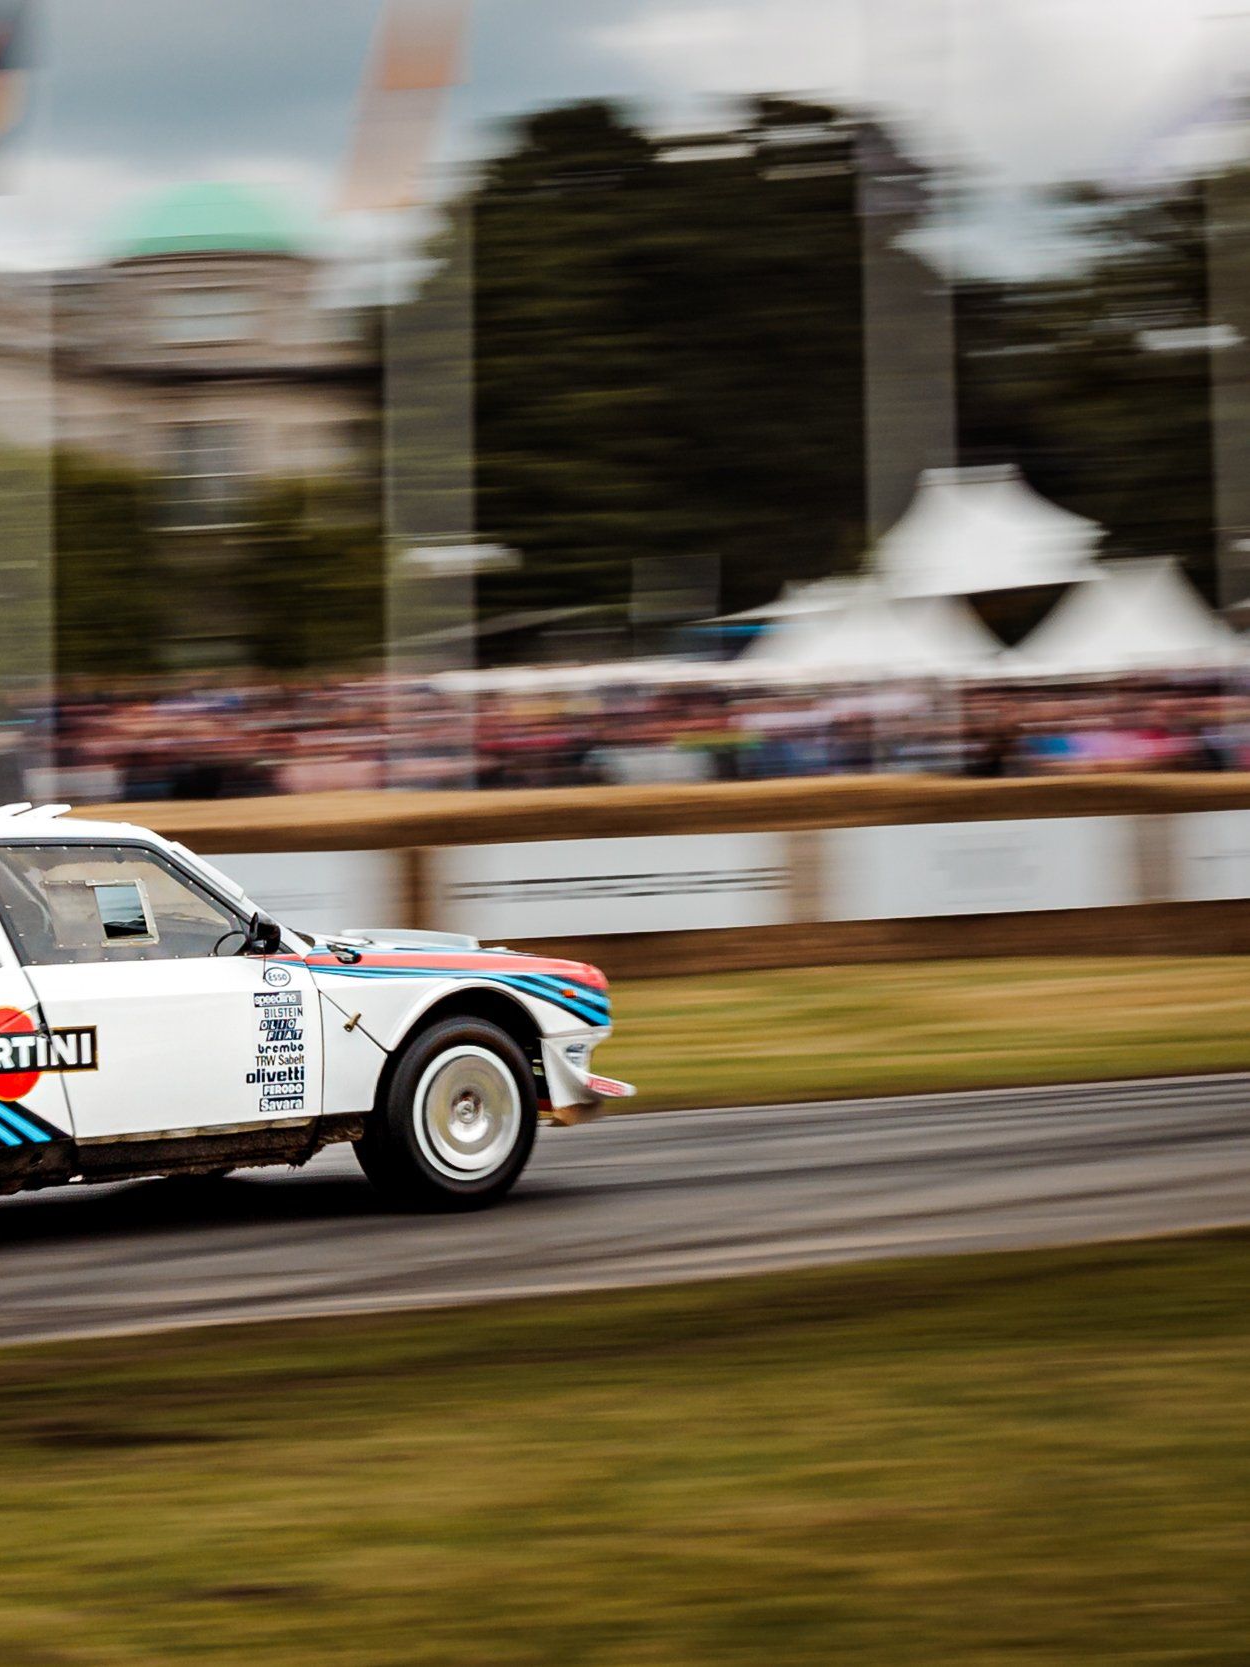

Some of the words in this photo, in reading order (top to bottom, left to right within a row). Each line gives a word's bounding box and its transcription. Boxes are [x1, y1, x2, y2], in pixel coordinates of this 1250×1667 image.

[264, 1007, 304, 1019] BILSTEIN
[260, 1019, 296, 1031] OLIO
[268, 1030, 303, 1041] FIAT
[257, 1042, 304, 1054] brembo
[256, 1055, 276, 1067] TRW
[278, 1053, 305, 1066] Sabelt
[245, 1066, 305, 1084] olivetti
[263, 1083, 304, 1096] FERODO
[260, 1098, 303, 1112] Savara
